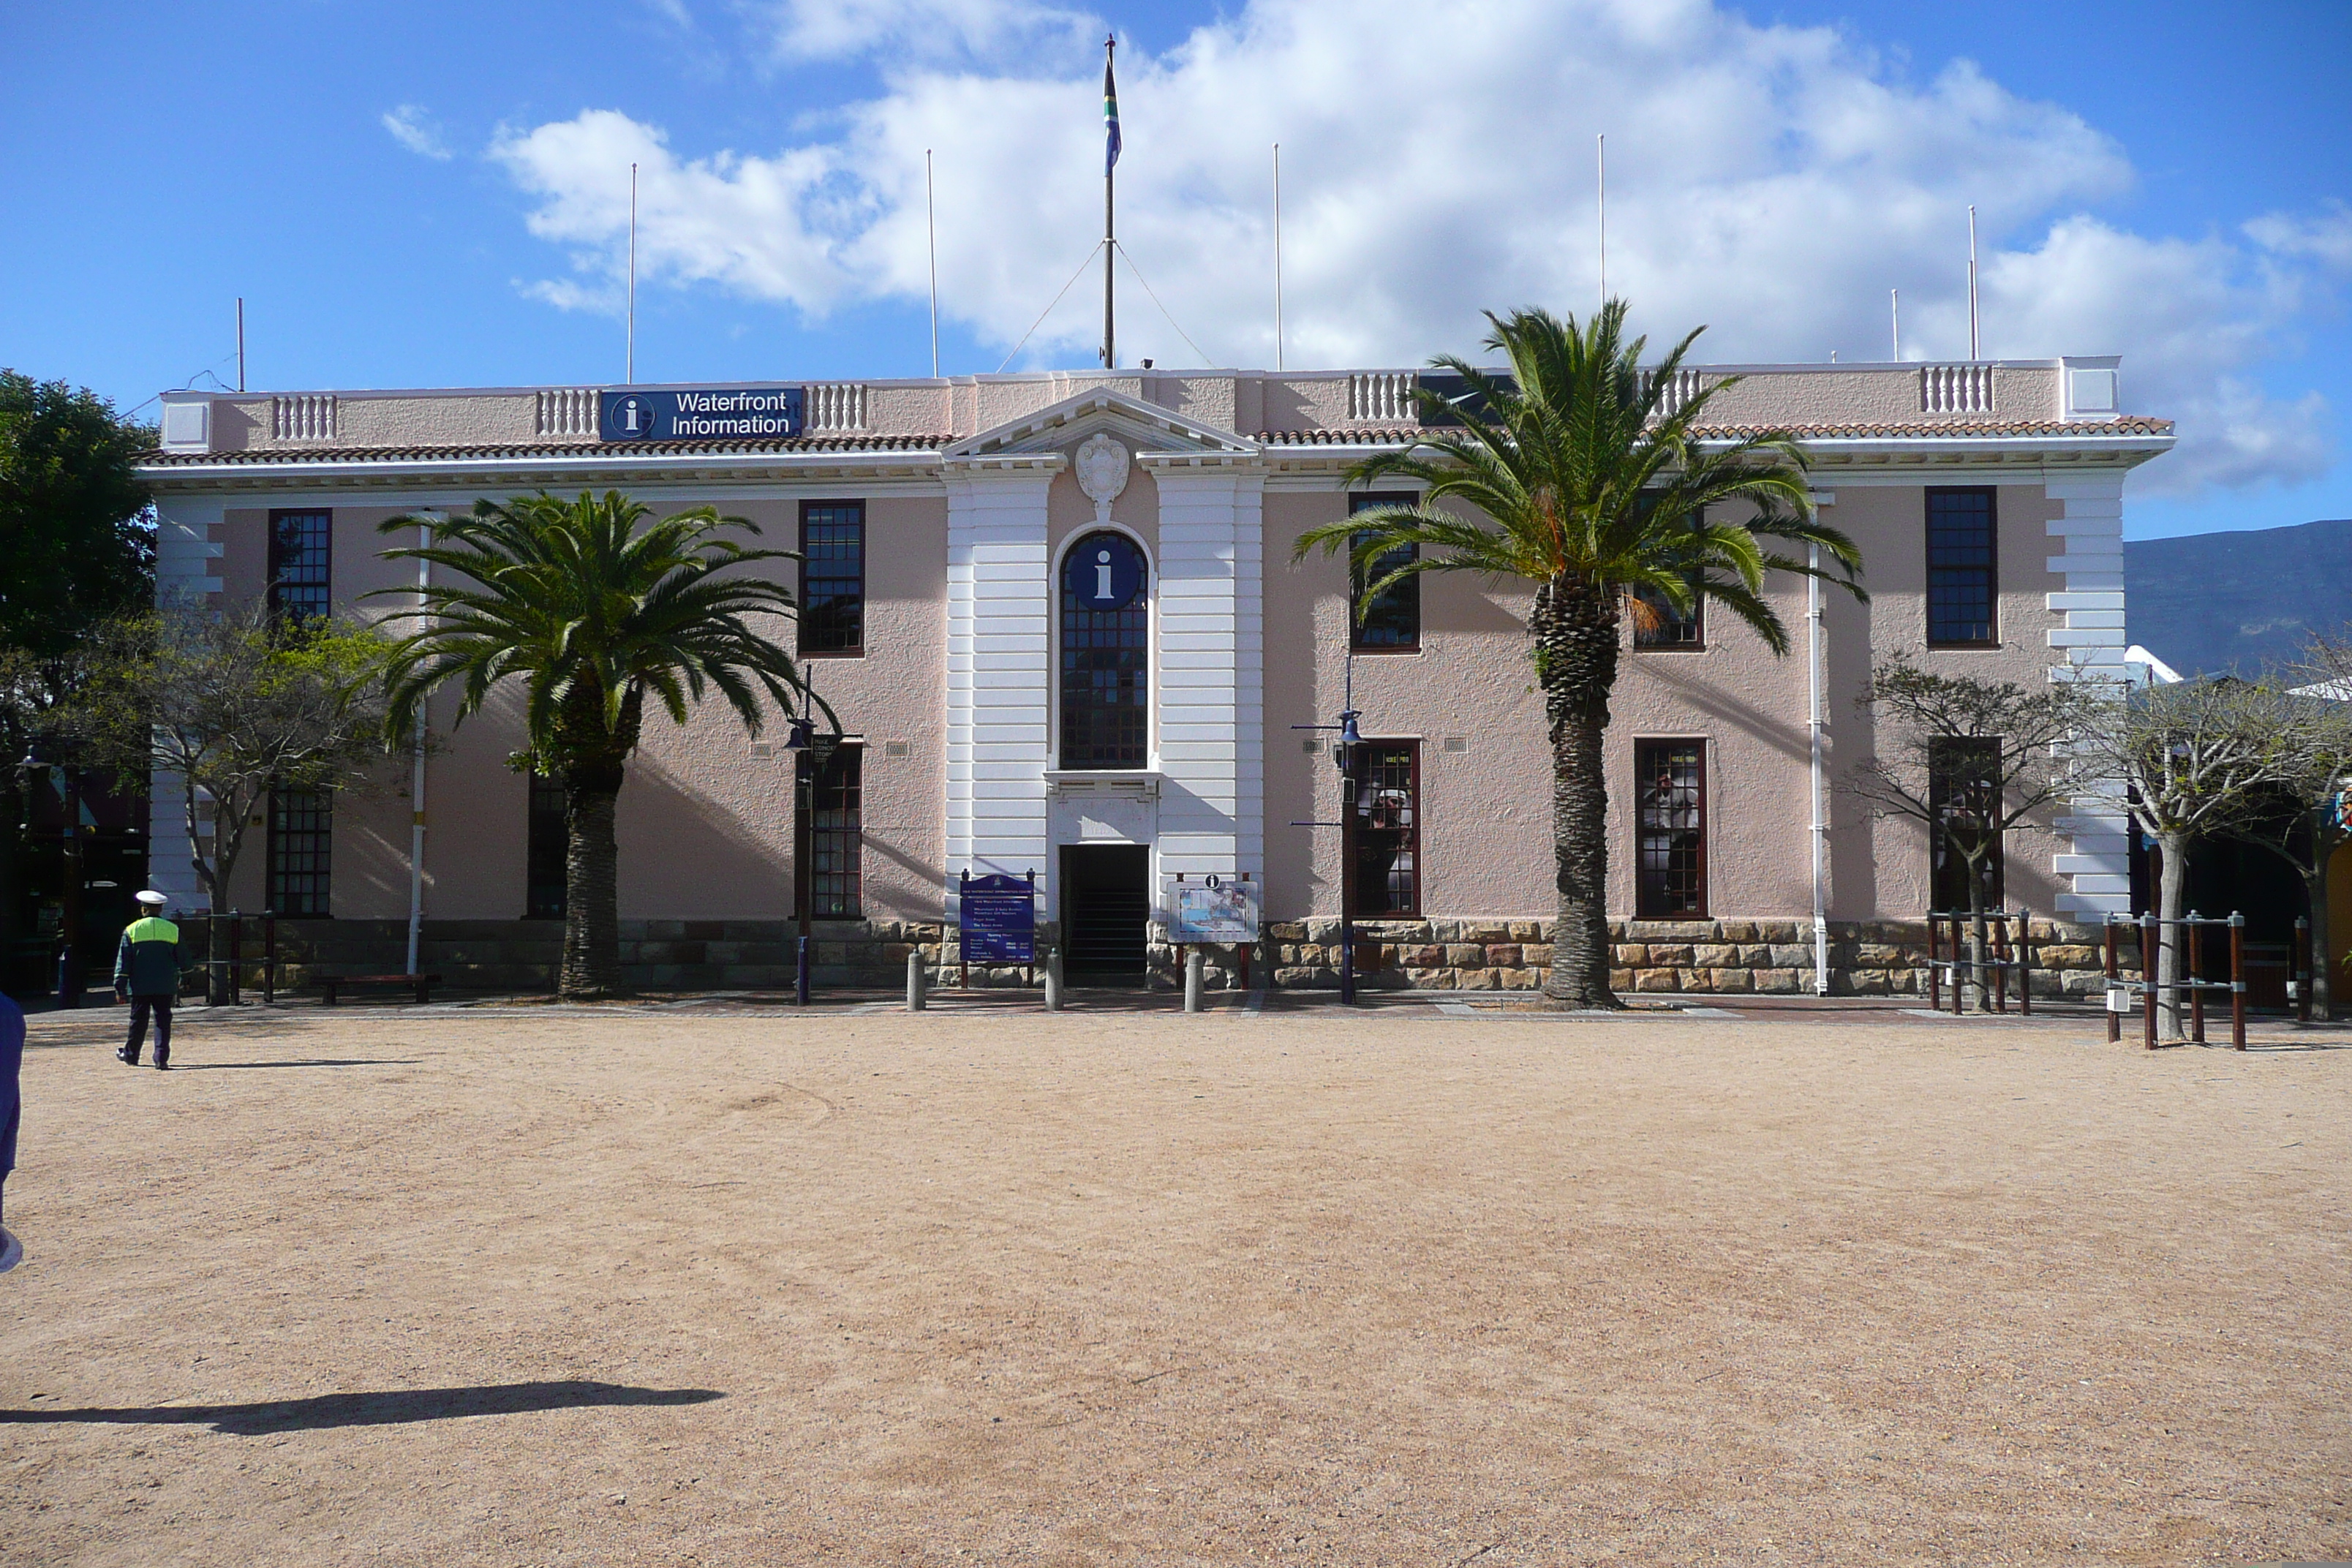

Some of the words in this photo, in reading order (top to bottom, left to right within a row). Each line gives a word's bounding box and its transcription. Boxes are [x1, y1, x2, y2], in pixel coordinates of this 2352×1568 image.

[676, 392, 786, 412] Waterfront
[625, 401, 638, 431] i
[672, 415, 789, 435] Information
[1094, 550, 1115, 599] i
